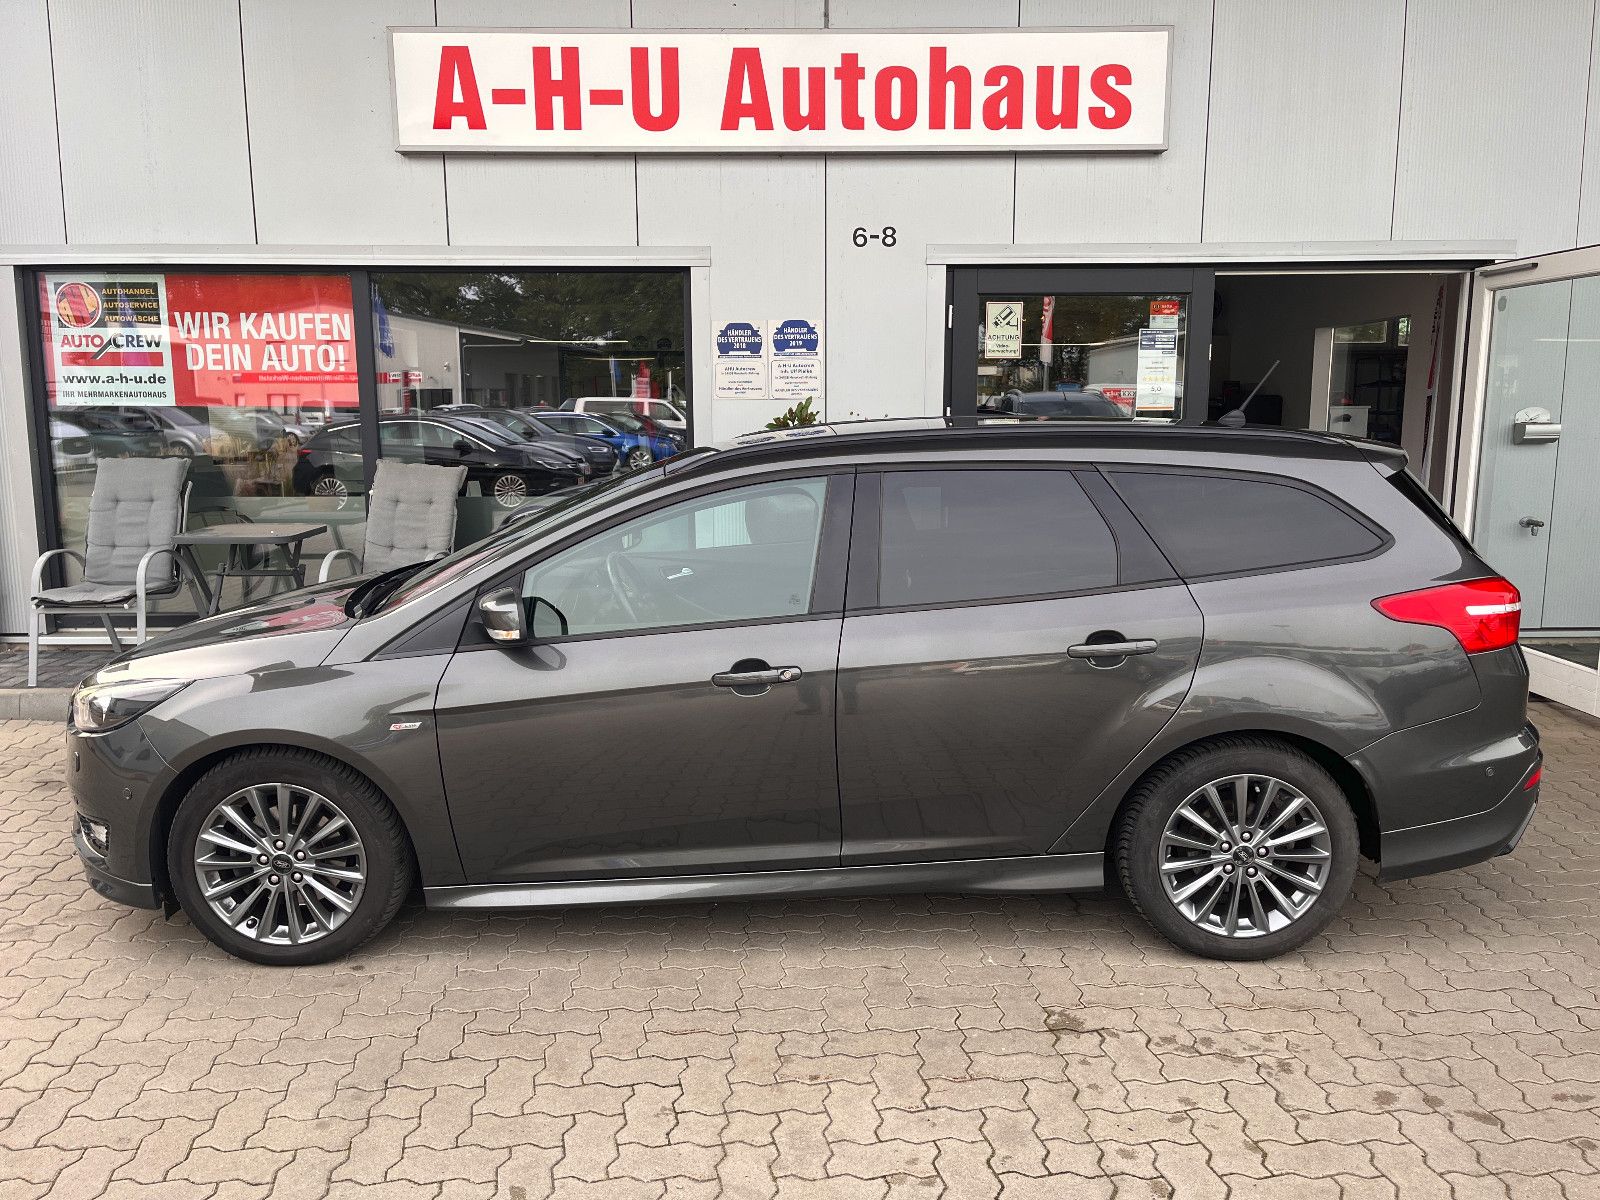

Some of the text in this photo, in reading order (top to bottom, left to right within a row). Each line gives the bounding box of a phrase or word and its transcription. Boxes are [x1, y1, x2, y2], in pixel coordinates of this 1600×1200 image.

[432, 46, 1132, 131] A-H-U Autohaus
[852, 226, 897, 247] 6-8
[104, 314, 159, 322] AUTOWÄSCHE
[174, 311, 351, 341] WIR KAUFEN
[60, 333, 163, 348] AUTO CREW
[185, 343, 346, 371] DEIN AUTO!
[62, 373, 167, 384] www.a-h-u.de
[62, 390, 75, 398] IHR
